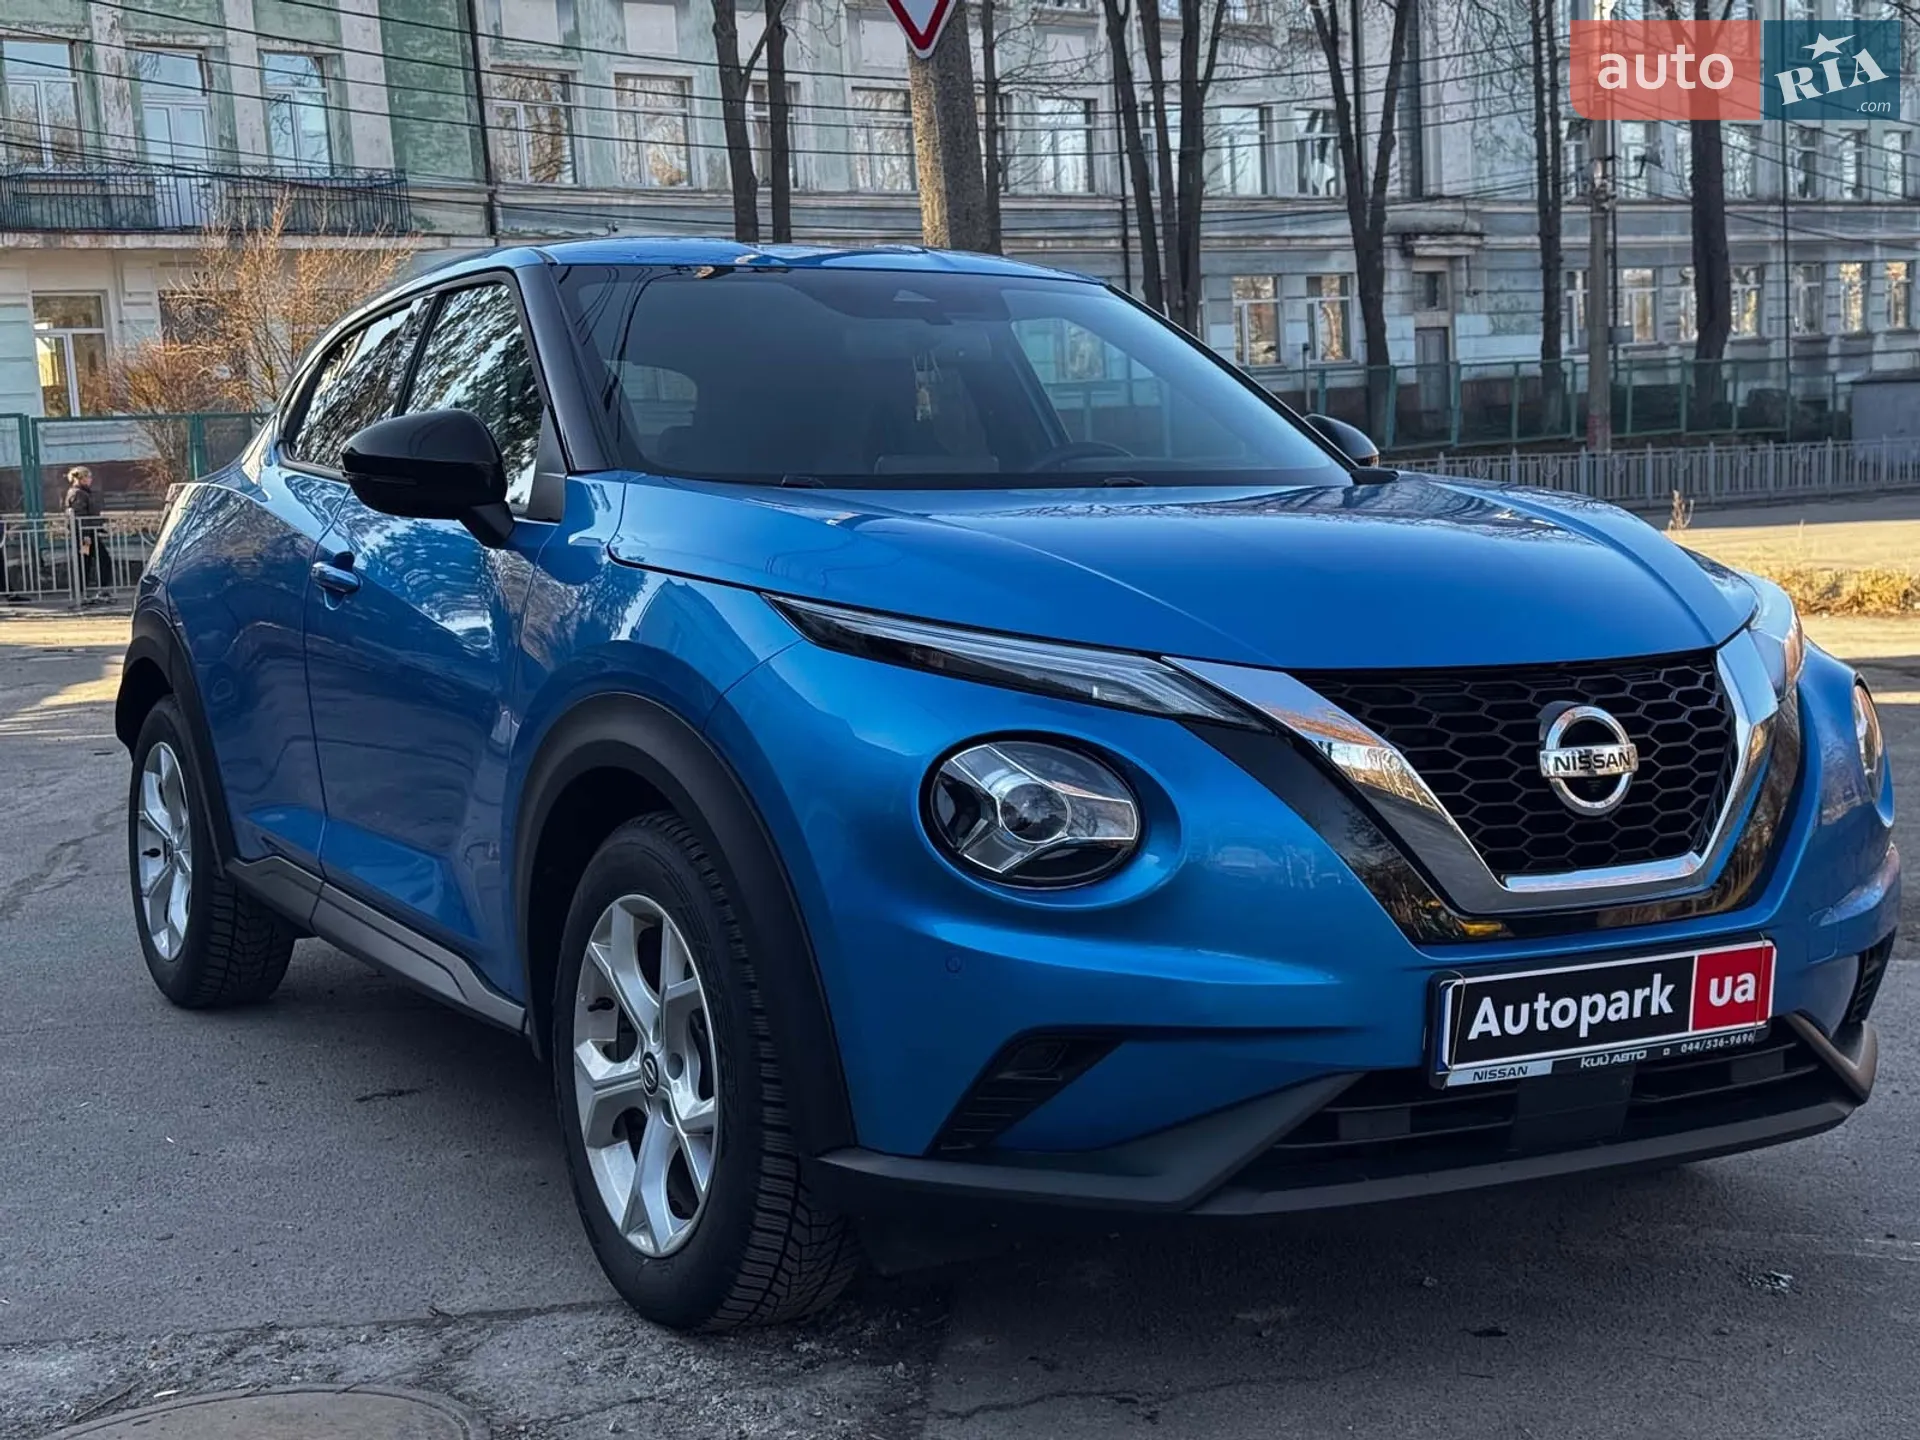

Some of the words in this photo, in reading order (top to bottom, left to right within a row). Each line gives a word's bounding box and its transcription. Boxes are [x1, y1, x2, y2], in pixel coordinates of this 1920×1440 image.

[1554, 751, 1631, 772] NISSAN
[1467, 973, 1676, 1040] Autopark
[1709, 972, 1757, 1008] ua
[1472, 1065, 1528, 1082] NISSAN
